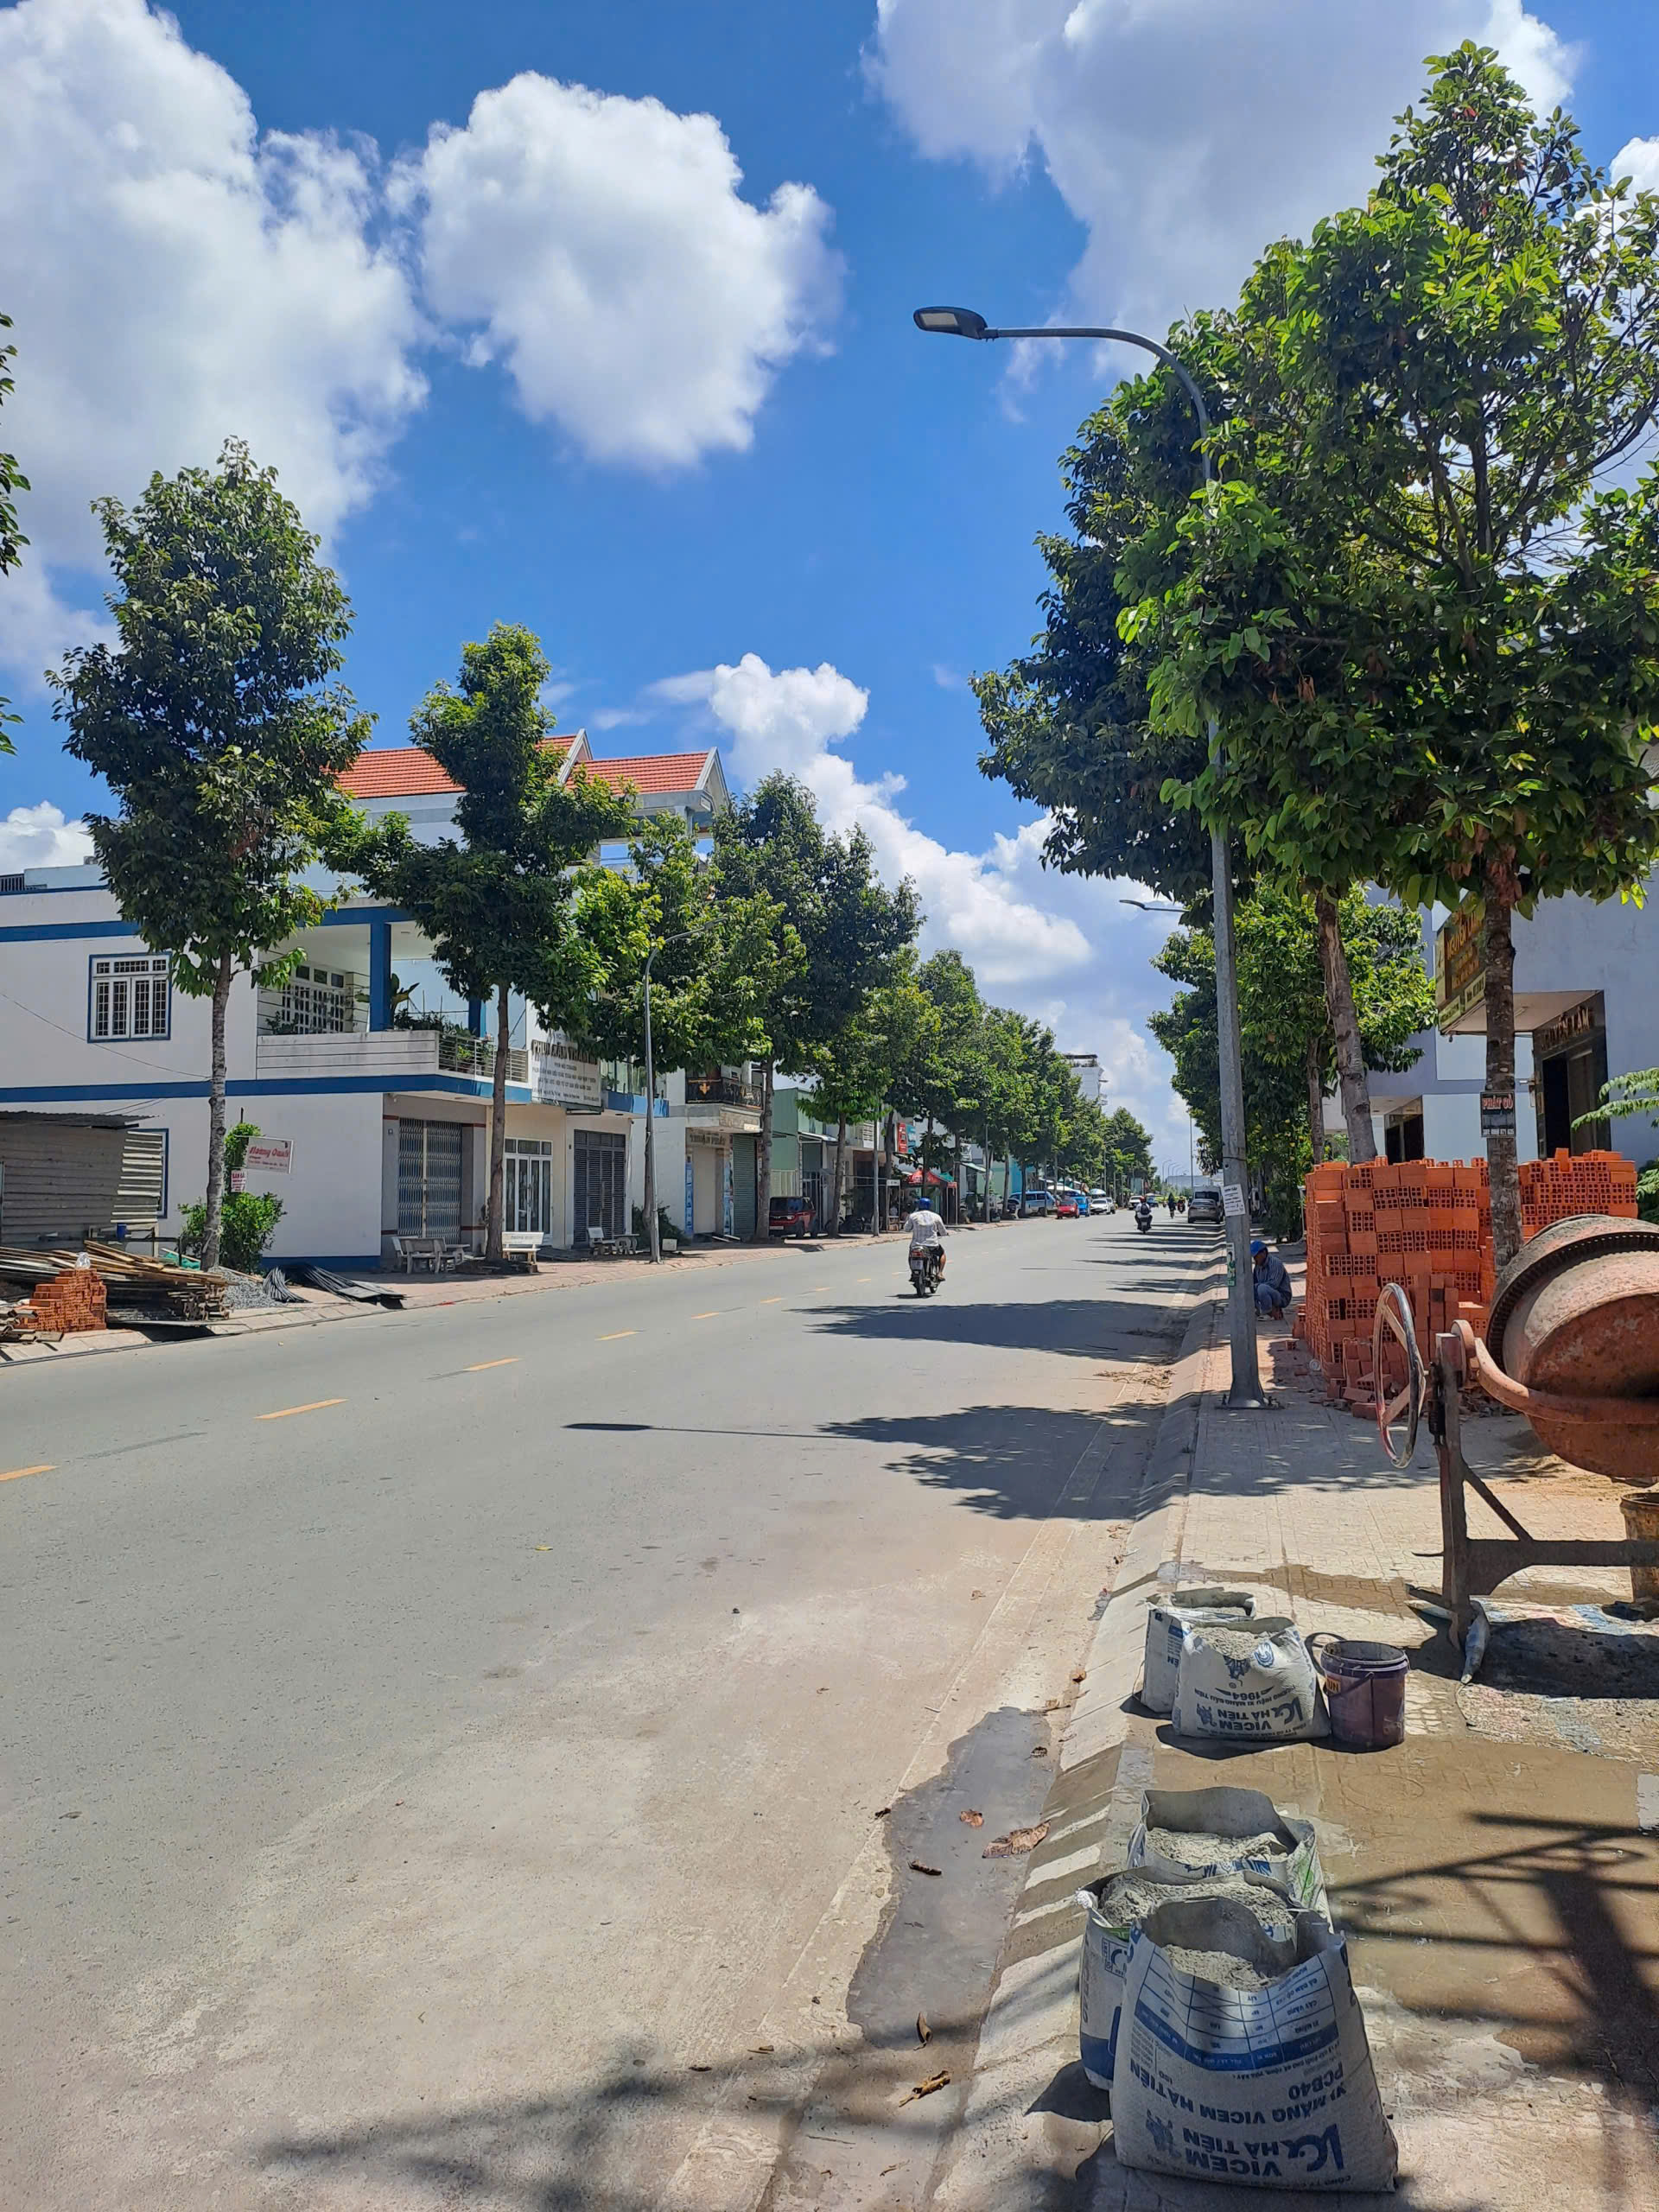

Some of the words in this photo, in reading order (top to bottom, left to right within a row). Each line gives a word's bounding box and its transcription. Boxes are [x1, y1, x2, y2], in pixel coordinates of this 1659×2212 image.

[1232, 1692, 1260, 1700] 1964
[1217, 1709, 1249, 1721] TIÊN
[1251, 1710, 1270, 1721] HÀ
[1219, 1719, 1272, 1731] VICEM
[1288, 2062, 1344, 2100] PCB40
[1200, 2104, 1265, 2124] VICEM
[1272, 2094, 1326, 2120] MĂNG
[1183, 2127, 1239, 2155] TIÊN
[1244, 2141, 1280, 2160] HÀ
[1185, 2148, 1282, 2177] VICEM
